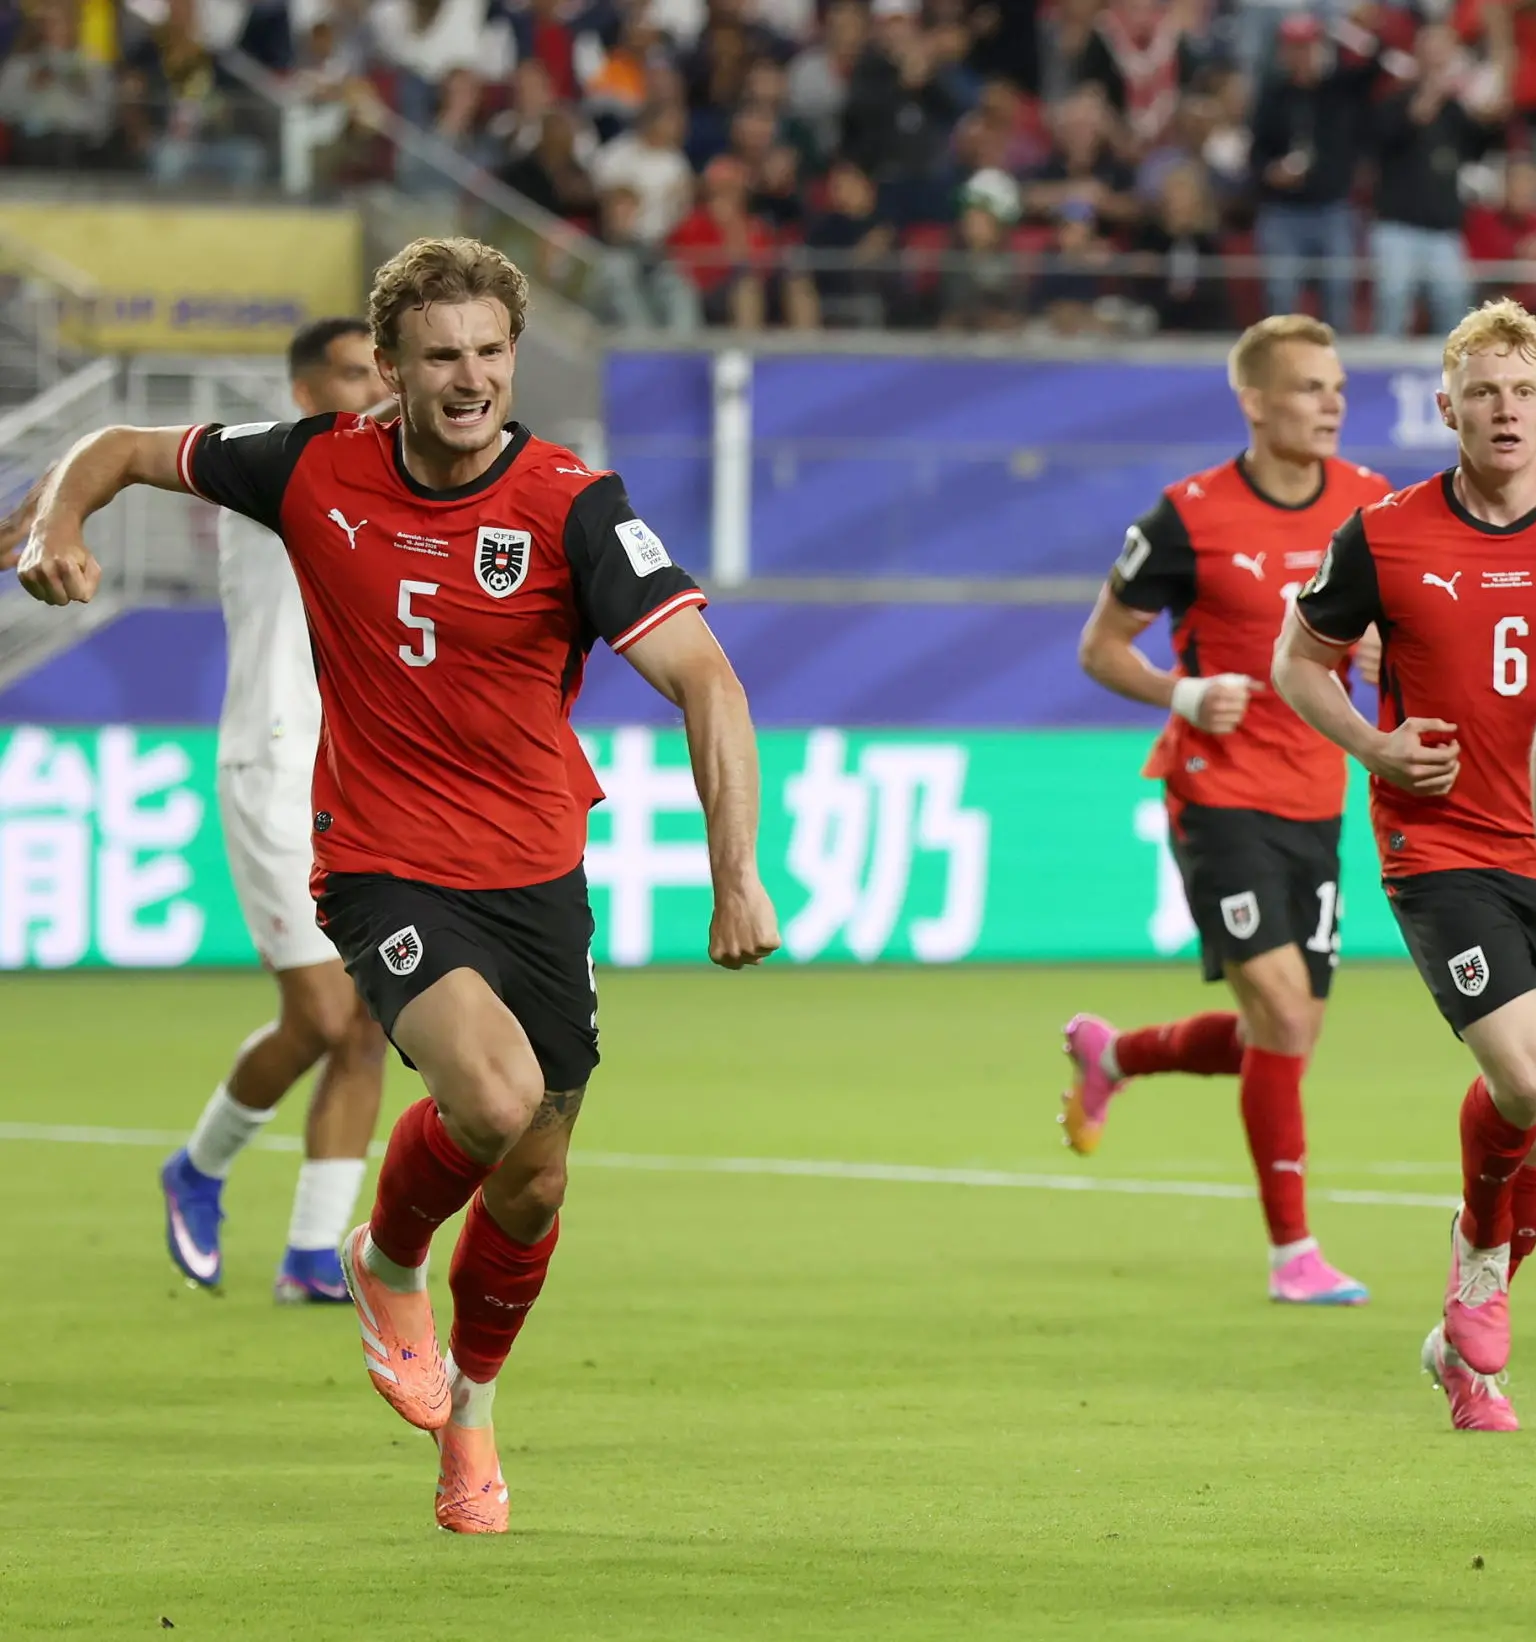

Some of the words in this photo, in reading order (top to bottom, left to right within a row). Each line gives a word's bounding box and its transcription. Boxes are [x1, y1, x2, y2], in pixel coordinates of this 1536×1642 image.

[397, 579, 440, 667] 5
[1492, 616, 1530, 697] 6
[1306, 880, 1344, 954] 1
